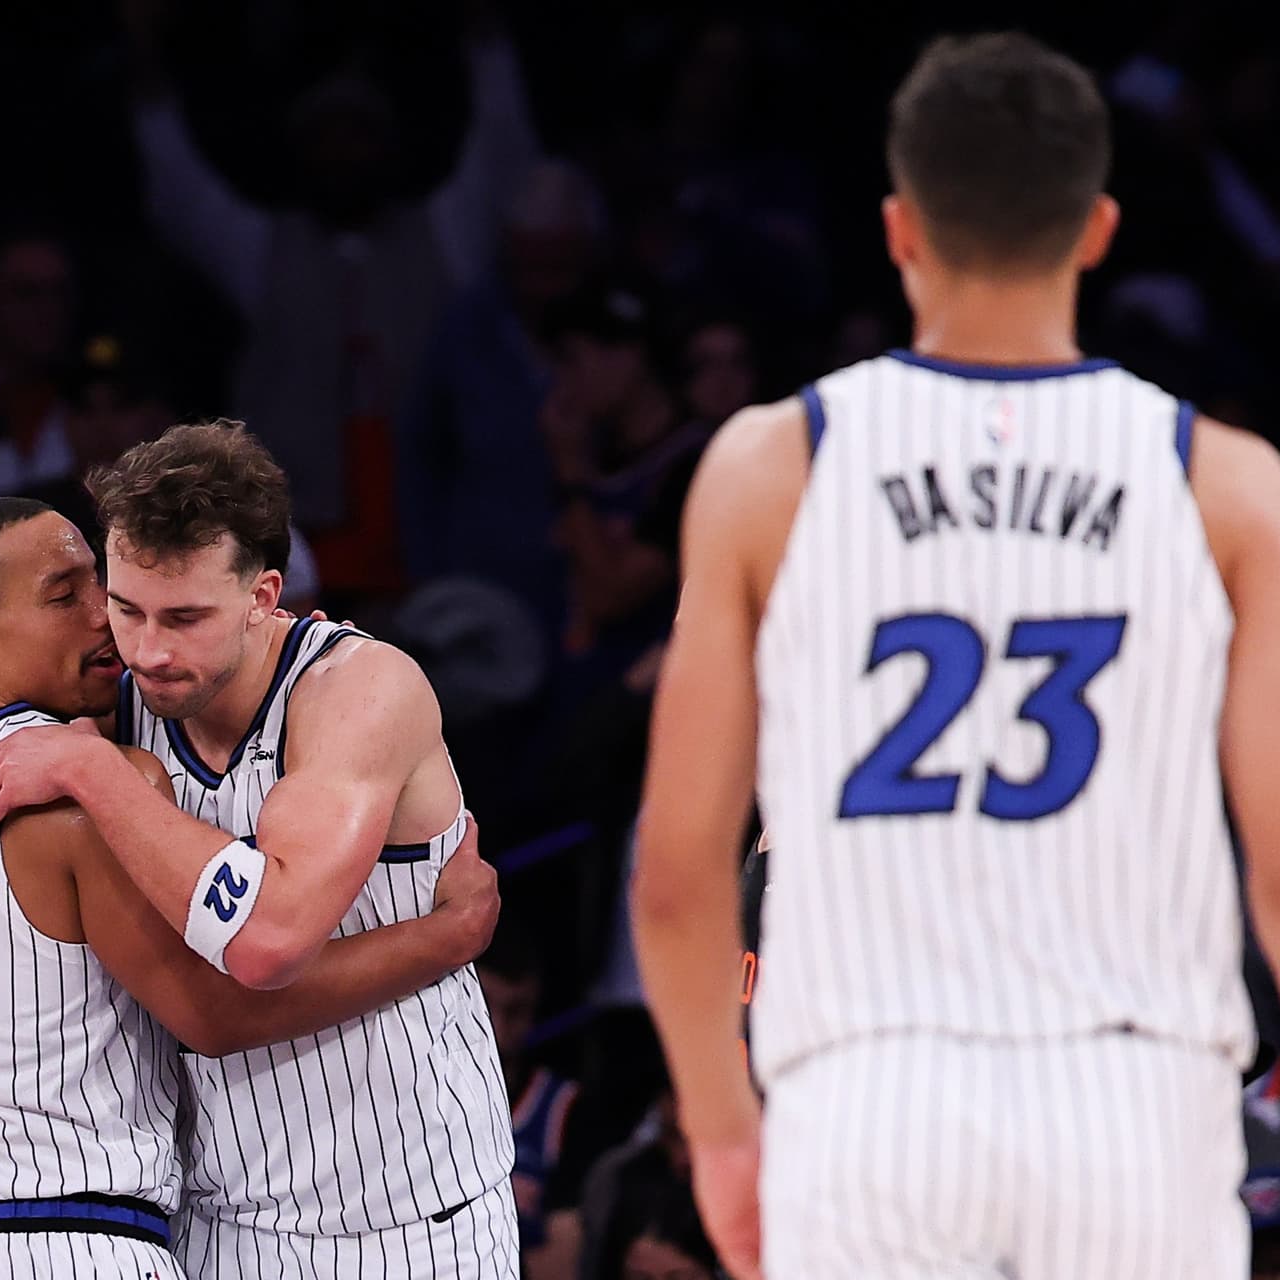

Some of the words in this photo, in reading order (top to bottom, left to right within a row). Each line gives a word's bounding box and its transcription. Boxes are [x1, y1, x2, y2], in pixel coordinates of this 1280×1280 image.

[970, 464, 1126, 551] SILVA
[836, 611, 1129, 822] 23
[203, 861, 249, 923] 22
